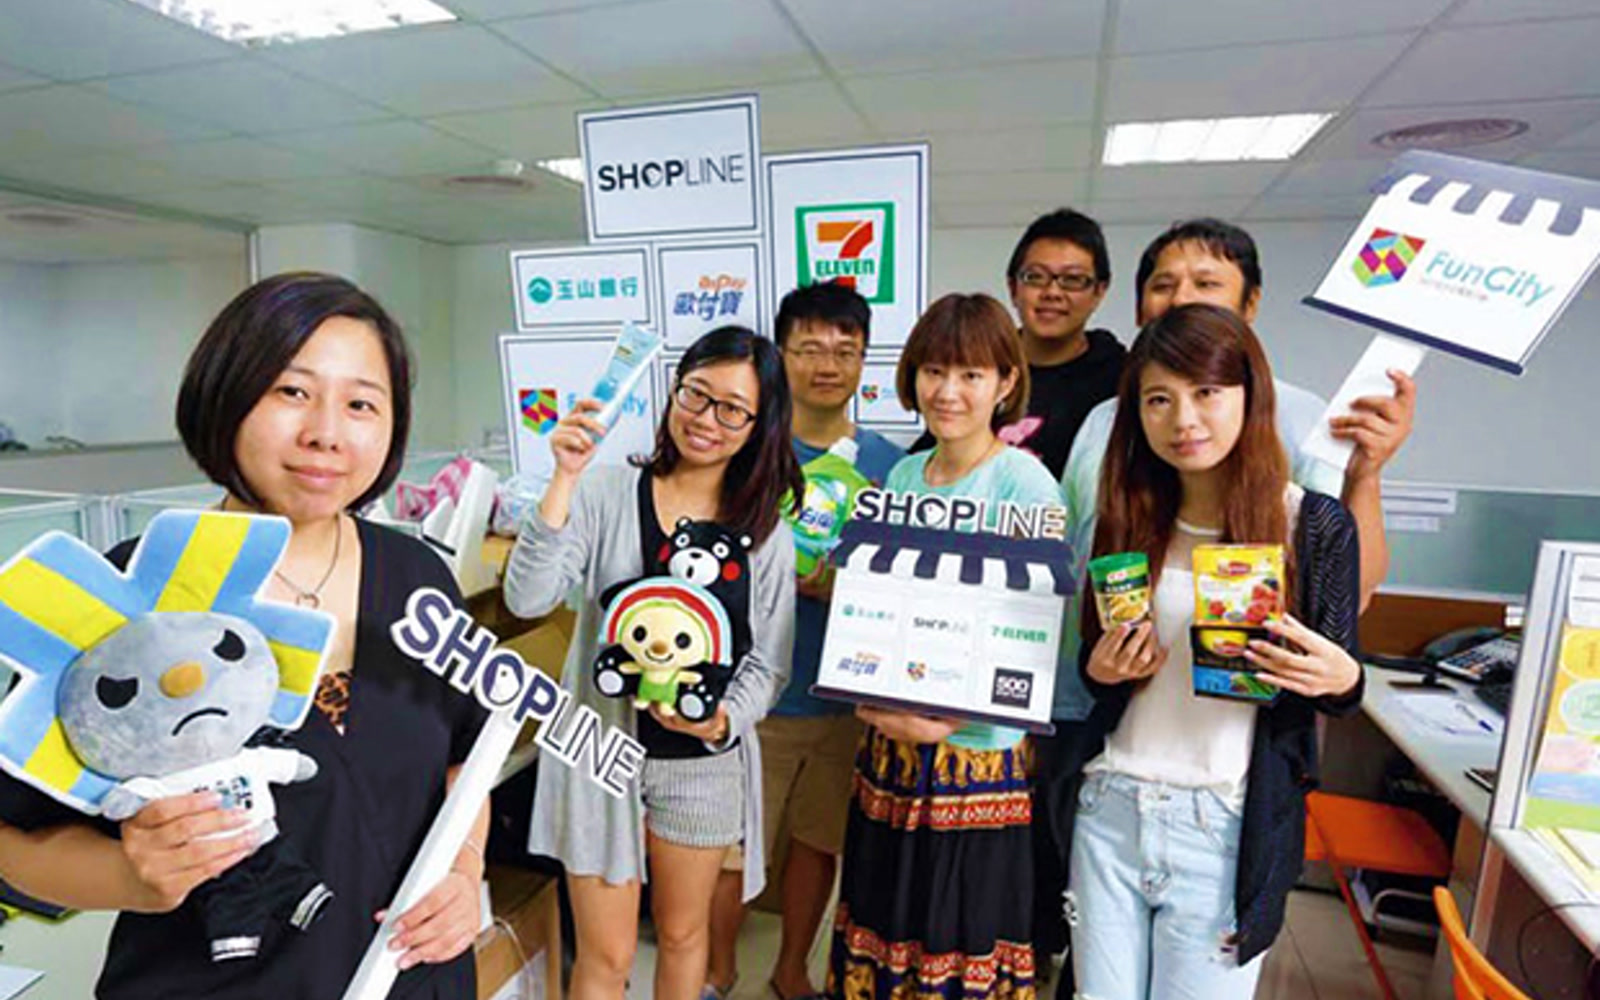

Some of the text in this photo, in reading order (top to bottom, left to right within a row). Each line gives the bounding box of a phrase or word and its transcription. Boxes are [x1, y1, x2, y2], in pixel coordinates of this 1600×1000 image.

[598, 154, 744, 191] SHOPLINE
[817, 220, 874, 285] 7
[1425, 250, 1555, 307] FunCity
[855, 489, 1067, 539] SHOPLINE
[399, 592, 645, 794] SHOPLINE
